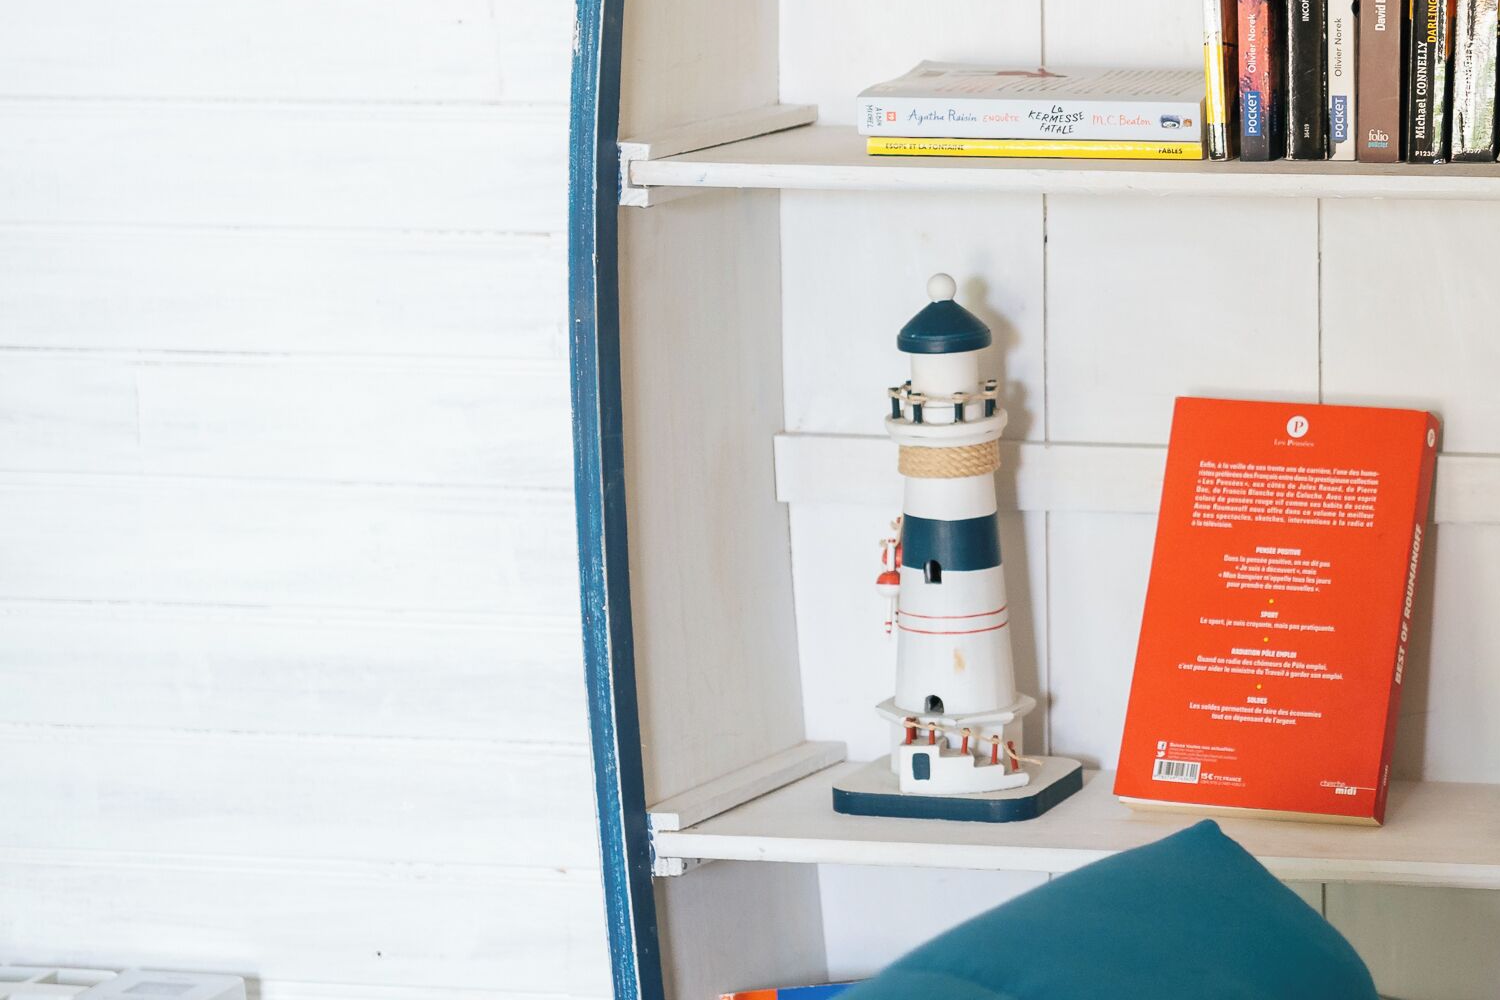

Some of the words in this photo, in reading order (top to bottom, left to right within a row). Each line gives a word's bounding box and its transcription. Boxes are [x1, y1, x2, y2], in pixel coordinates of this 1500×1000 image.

[1247, 14, 1256, 42] Norek
[1375, 5, 1386, 32] David
[1334, 18, 1344, 45] Norek
[1247, 44, 1256, 73] Olivier
[1334, 46, 1343, 77] Olivier
[1416, 40, 1428, 96] CONNELLY
[909, 109, 944, 126] Agatha
[948, 109, 976, 122] Raisin
[1028, 110, 1084, 124] KERMESSE
[1051, 105, 1063, 114] La
[1120, 115, 1151, 127] Beaton
[1248, 94, 1257, 134] POCKET
[1335, 98, 1344, 138] POCKET
[1415, 98, 1426, 139] Michael
[1040, 123, 1073, 135] FATALE
[1368, 129, 1389, 142] folio
[1158, 147, 1183, 155] FABLES
[1403, 523, 1422, 620] ROUMANOFF
[1400, 622, 1409, 643] OF
[1197, 655, 1216, 663] Quand
[1394, 645, 1406, 685] BEST
[1265, 668, 1285, 676] Travail
[1335, 786, 1357, 796] midi
